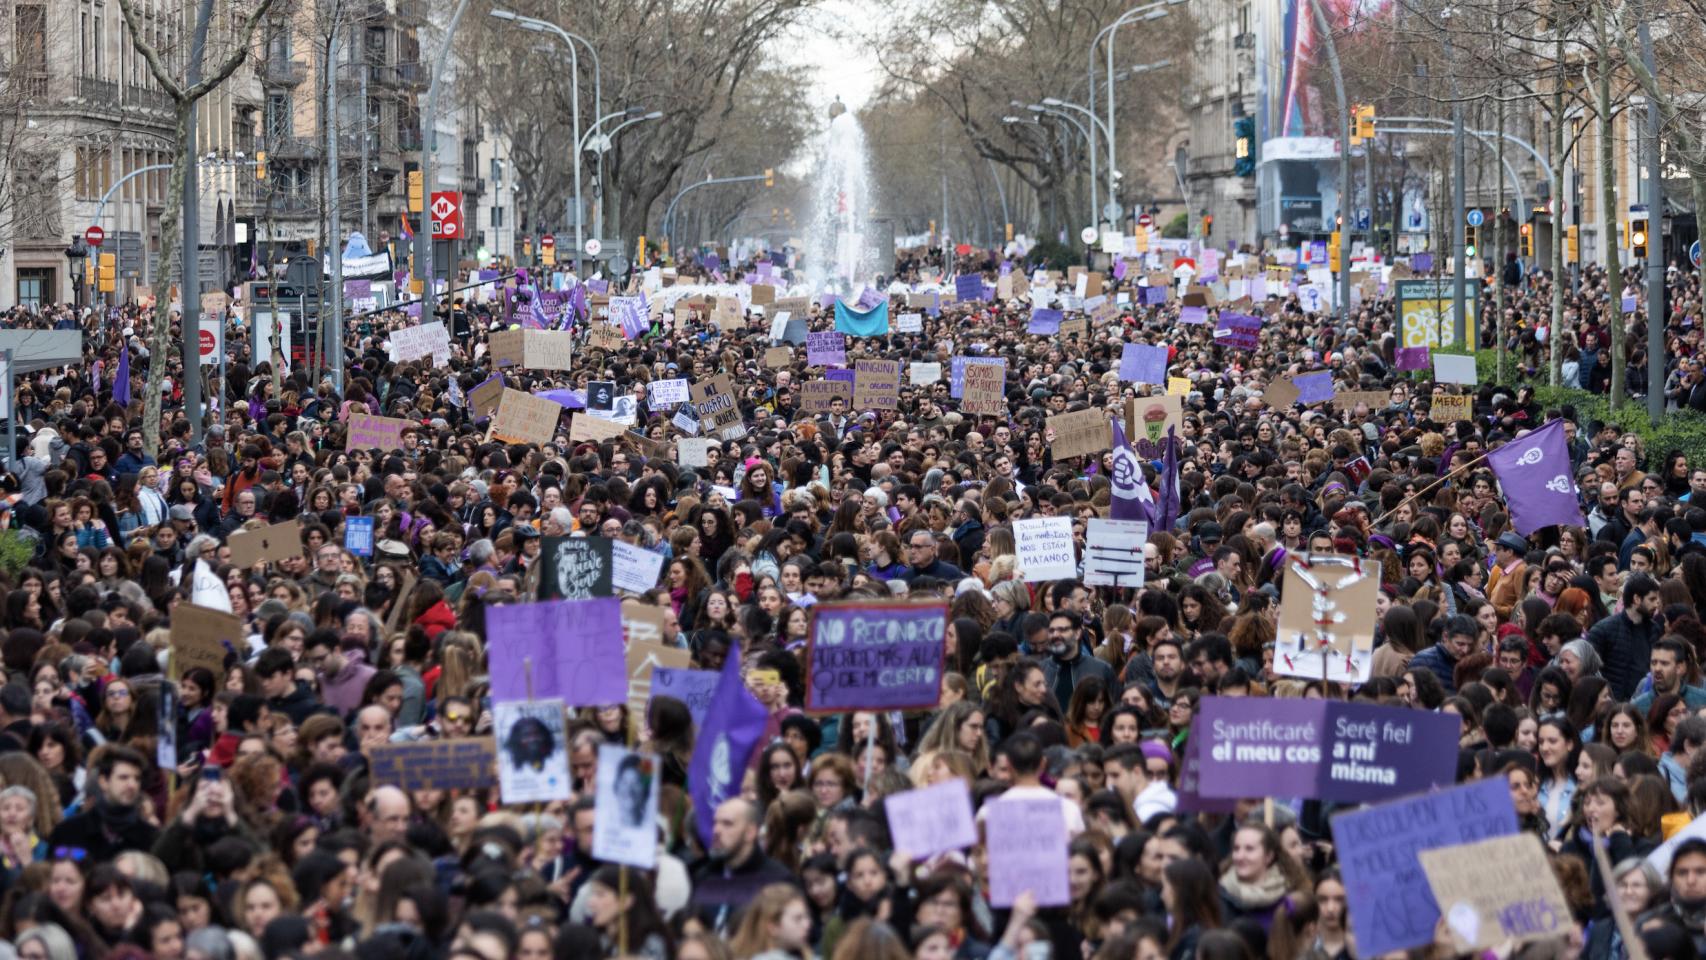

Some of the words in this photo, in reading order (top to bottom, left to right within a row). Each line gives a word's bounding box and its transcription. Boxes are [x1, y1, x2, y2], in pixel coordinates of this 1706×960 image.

[437, 203, 448, 213] M
[1360, 210, 1368, 222] P
[703, 382, 718, 397] MI
[699, 393, 732, 416] CUERPO
[1434, 396, 1467, 407] MERCI
[703, 417, 716, 431] NO
[1042, 541, 1066, 550] ESTÁN
[1023, 553, 1070, 566] MATANDO
[817, 618, 845, 646] NO
[850, 617, 945, 645] RECONOZCO
[838, 671, 860, 688] DE
[1213, 719, 1316, 741] Santificaré
[1335, 717, 1376, 740] Seré
[1383, 723, 1412, 744] fiel
[1211, 743, 1231, 761] el
[1236, 746, 1280, 762] meu
[1285, 746, 1321, 763] cos
[1332, 744, 1345, 759] a
[1350, 741, 1375, 761] mí
[1331, 763, 1396, 784] misma
[1452, 790, 1489, 820] LAS
